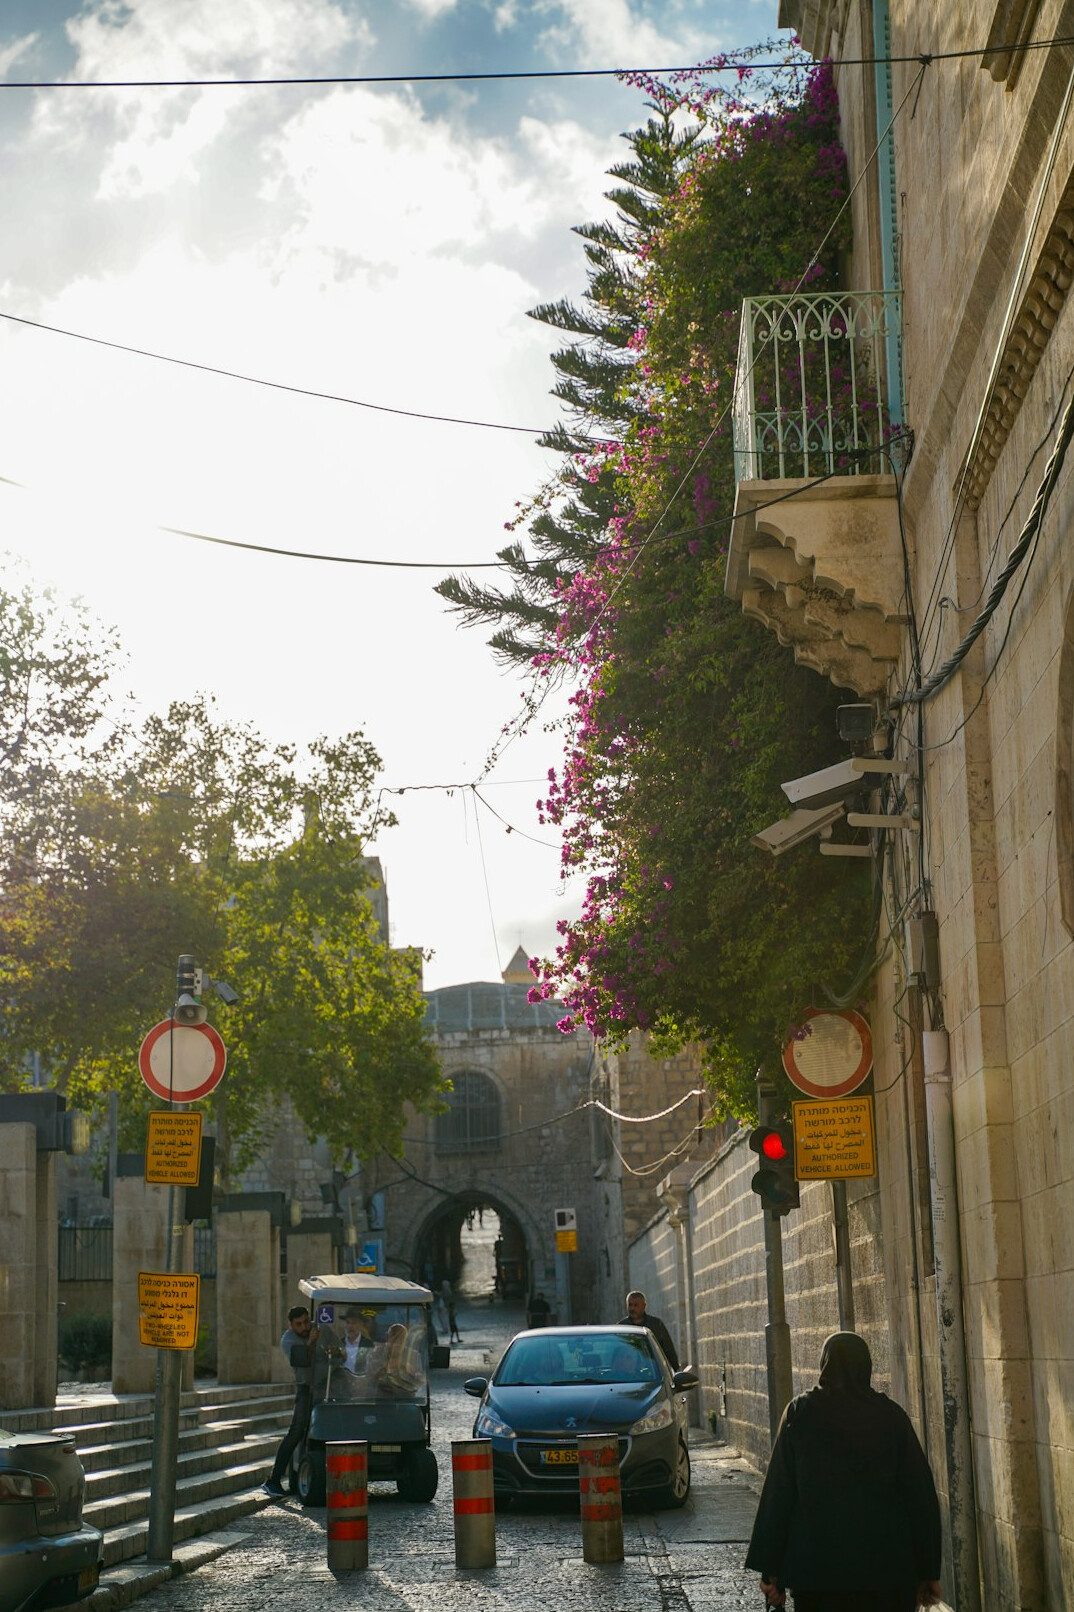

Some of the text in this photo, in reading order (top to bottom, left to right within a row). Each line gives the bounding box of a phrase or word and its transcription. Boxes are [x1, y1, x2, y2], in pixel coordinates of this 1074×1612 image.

[799, 1104, 866, 1117] הכניסה מותרת
[804, 1114, 861, 1127] לרכב מורשה
[812, 1152, 859, 1162] AUTHORIZED
[155, 1160, 188, 1168] AUTHORIZED
[800, 1162, 871, 1173] VEHICLE ALLOWED
[170, 1170, 196, 1178] ALLOWED
[172, 1280, 195, 1288] אסורה
